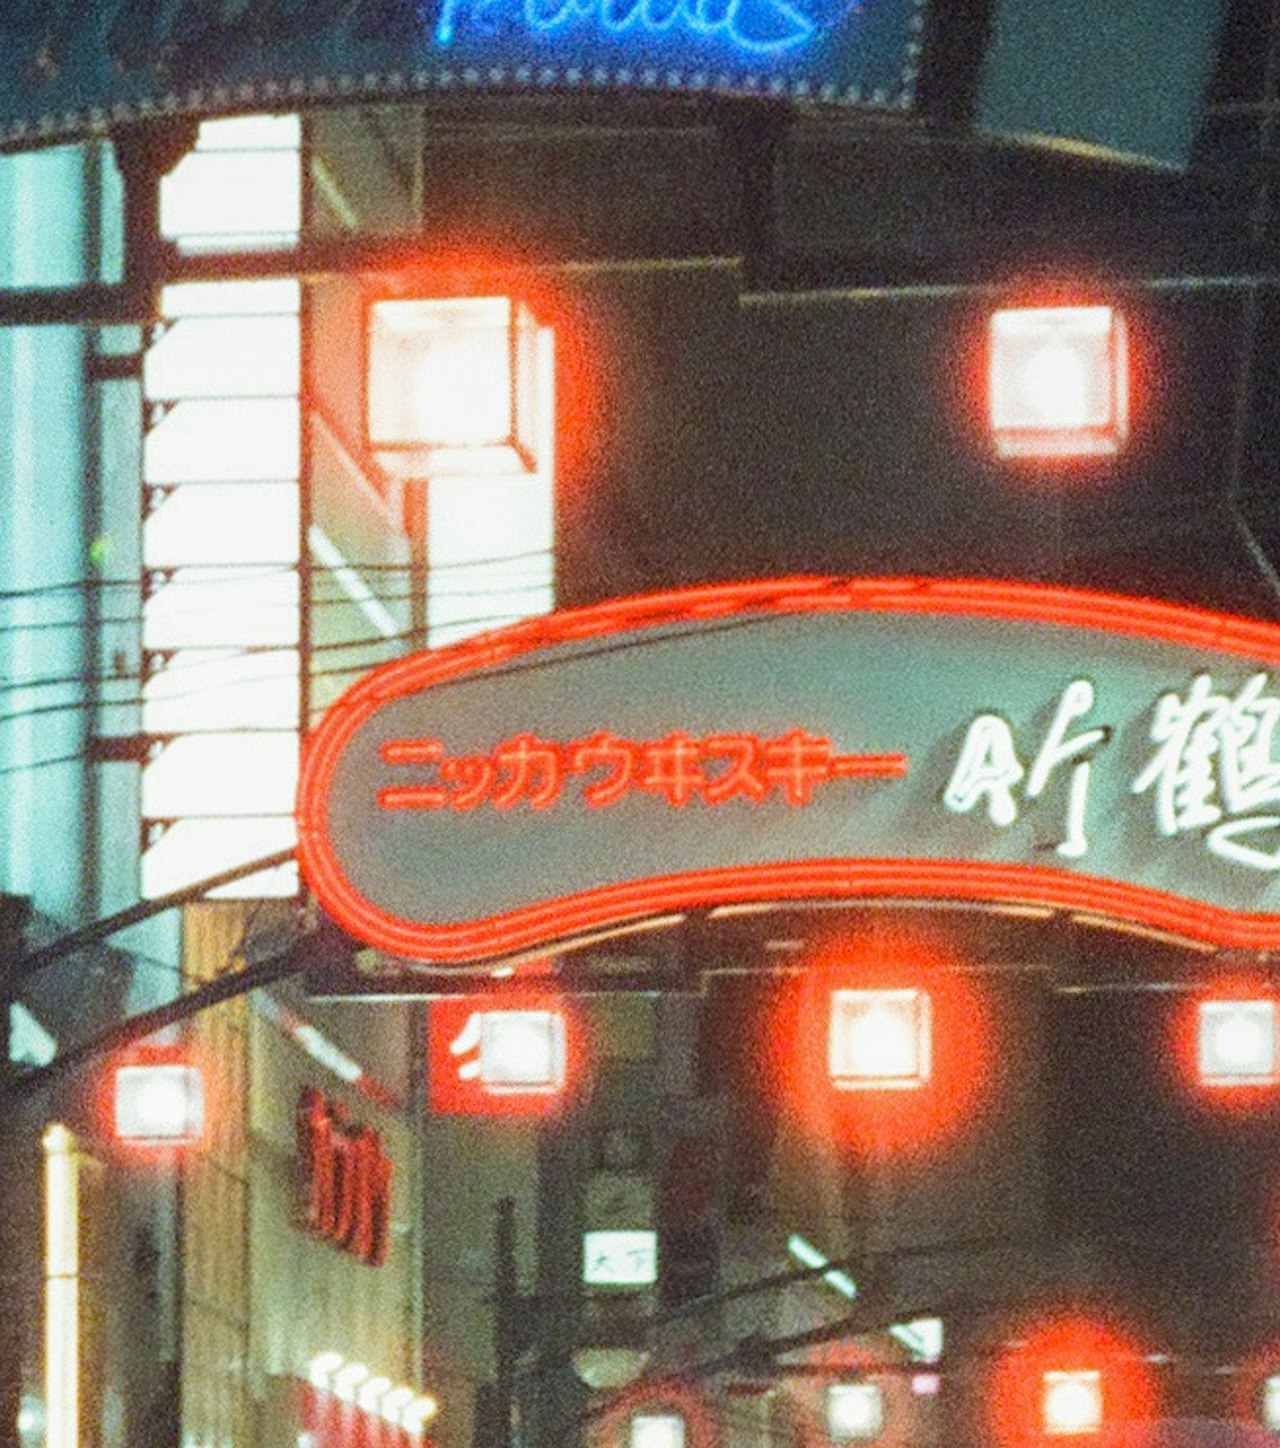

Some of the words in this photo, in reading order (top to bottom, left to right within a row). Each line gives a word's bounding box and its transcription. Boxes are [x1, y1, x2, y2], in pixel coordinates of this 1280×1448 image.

[376, 726, 910, 811] ニッカウヰスキー
